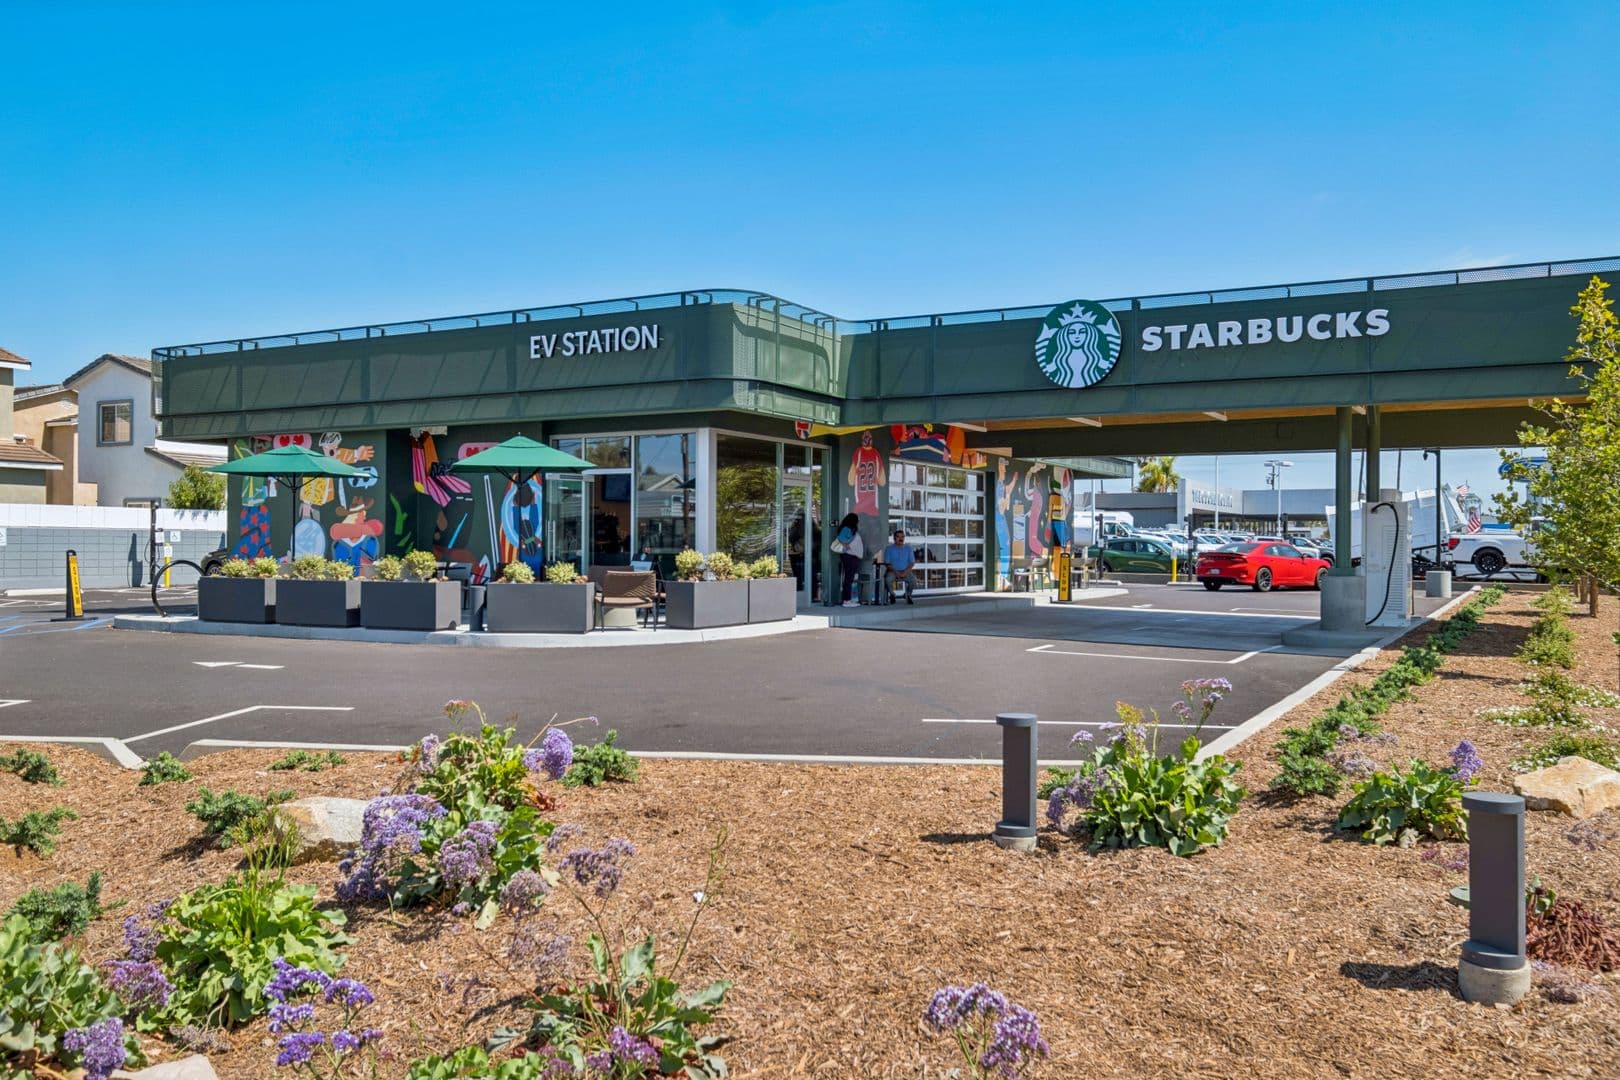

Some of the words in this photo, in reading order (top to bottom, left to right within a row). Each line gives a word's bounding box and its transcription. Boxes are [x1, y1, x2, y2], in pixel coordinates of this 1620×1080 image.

[530, 334, 557, 359] EV
[562, 324, 658, 357] STATION
[1142, 309, 1391, 352] STARBUCKS
